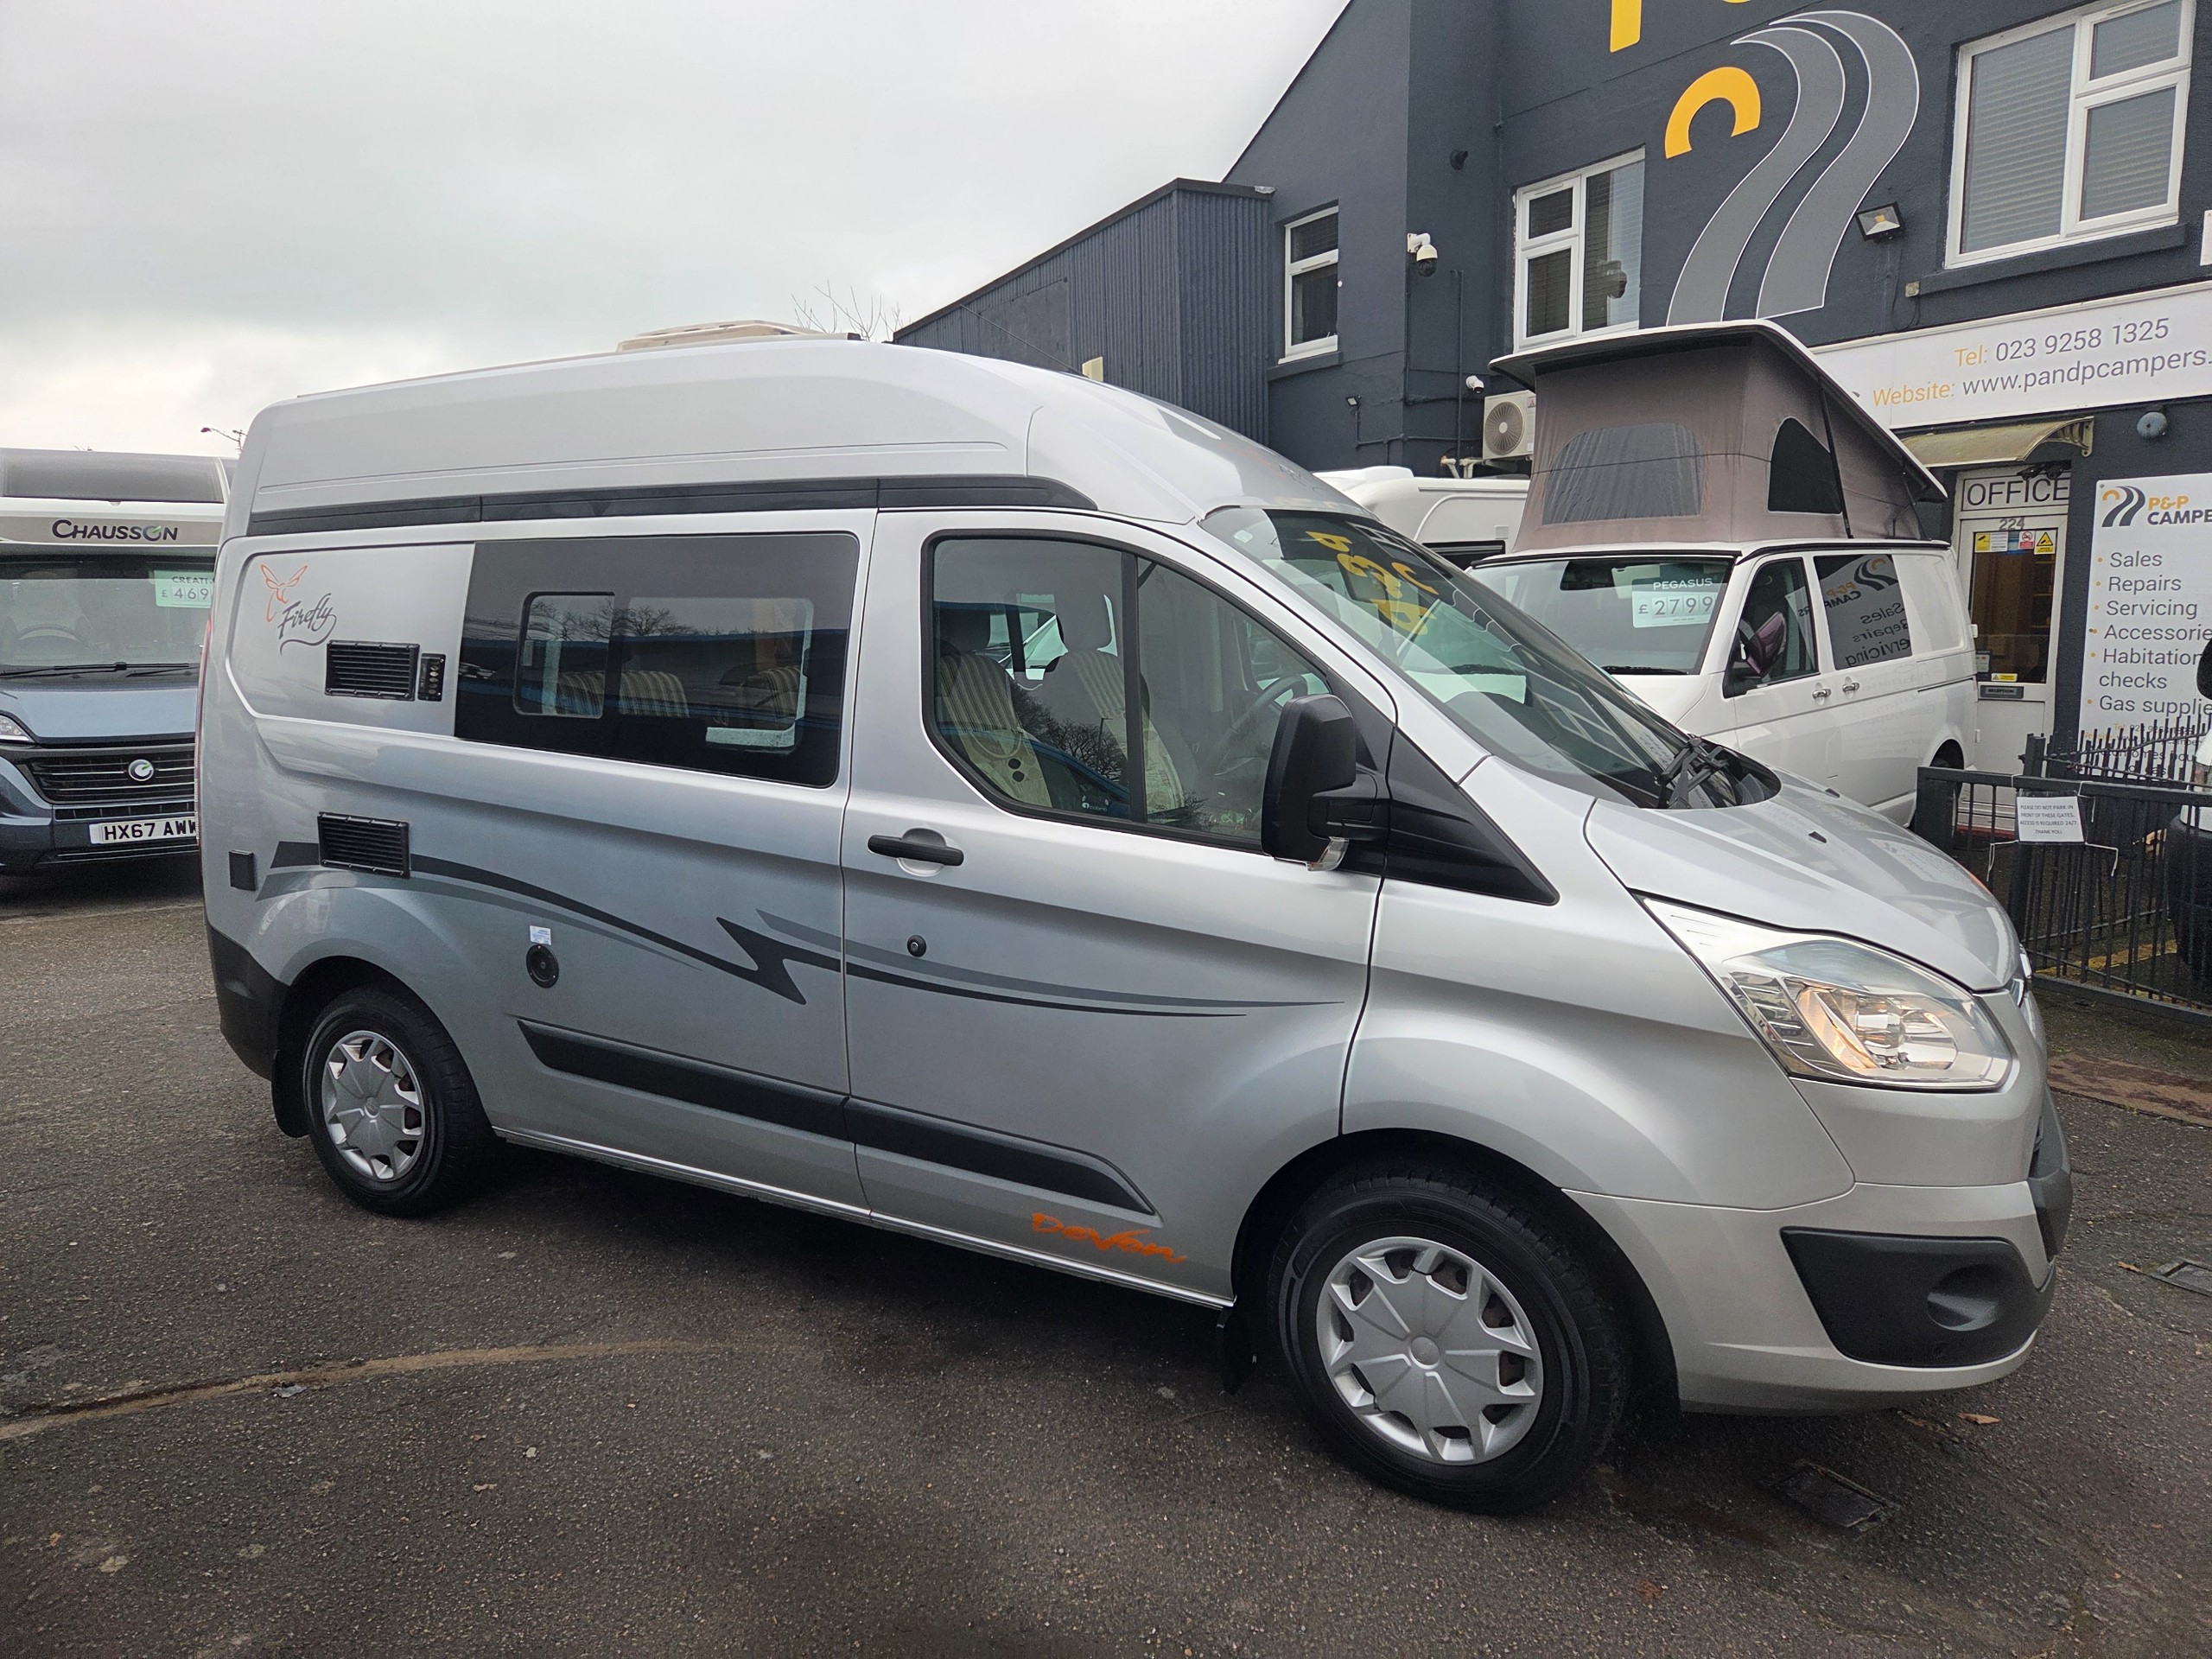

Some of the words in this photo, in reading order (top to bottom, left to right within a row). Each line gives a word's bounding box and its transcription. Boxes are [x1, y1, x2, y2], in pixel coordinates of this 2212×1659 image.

[1955, 344, 1987, 367] Tel:
[1996, 338, 2037, 361] 023
[2044, 327, 2102, 355] 9258
[2112, 317, 2170, 345] 1325
[1872, 380, 1955, 407] Website:
[1967, 477, 2069, 506] OFFICE
[2147, 495, 2190, 512] P&P
[52, 518, 178, 542] CHAUSSON
[1999, 517, 2025, 531] 224
[2109, 550, 2163, 568] Sales
[1653, 577, 1713, 591] PEGASUS
[2108, 575, 2182, 595] Repairs
[2106, 599, 2198, 620] Servicing
[276, 593, 337, 655] Firefly
[2099, 671, 2168, 690] checks
[2100, 695, 2136, 712] Gas
[104, 822, 156, 841] HX67
